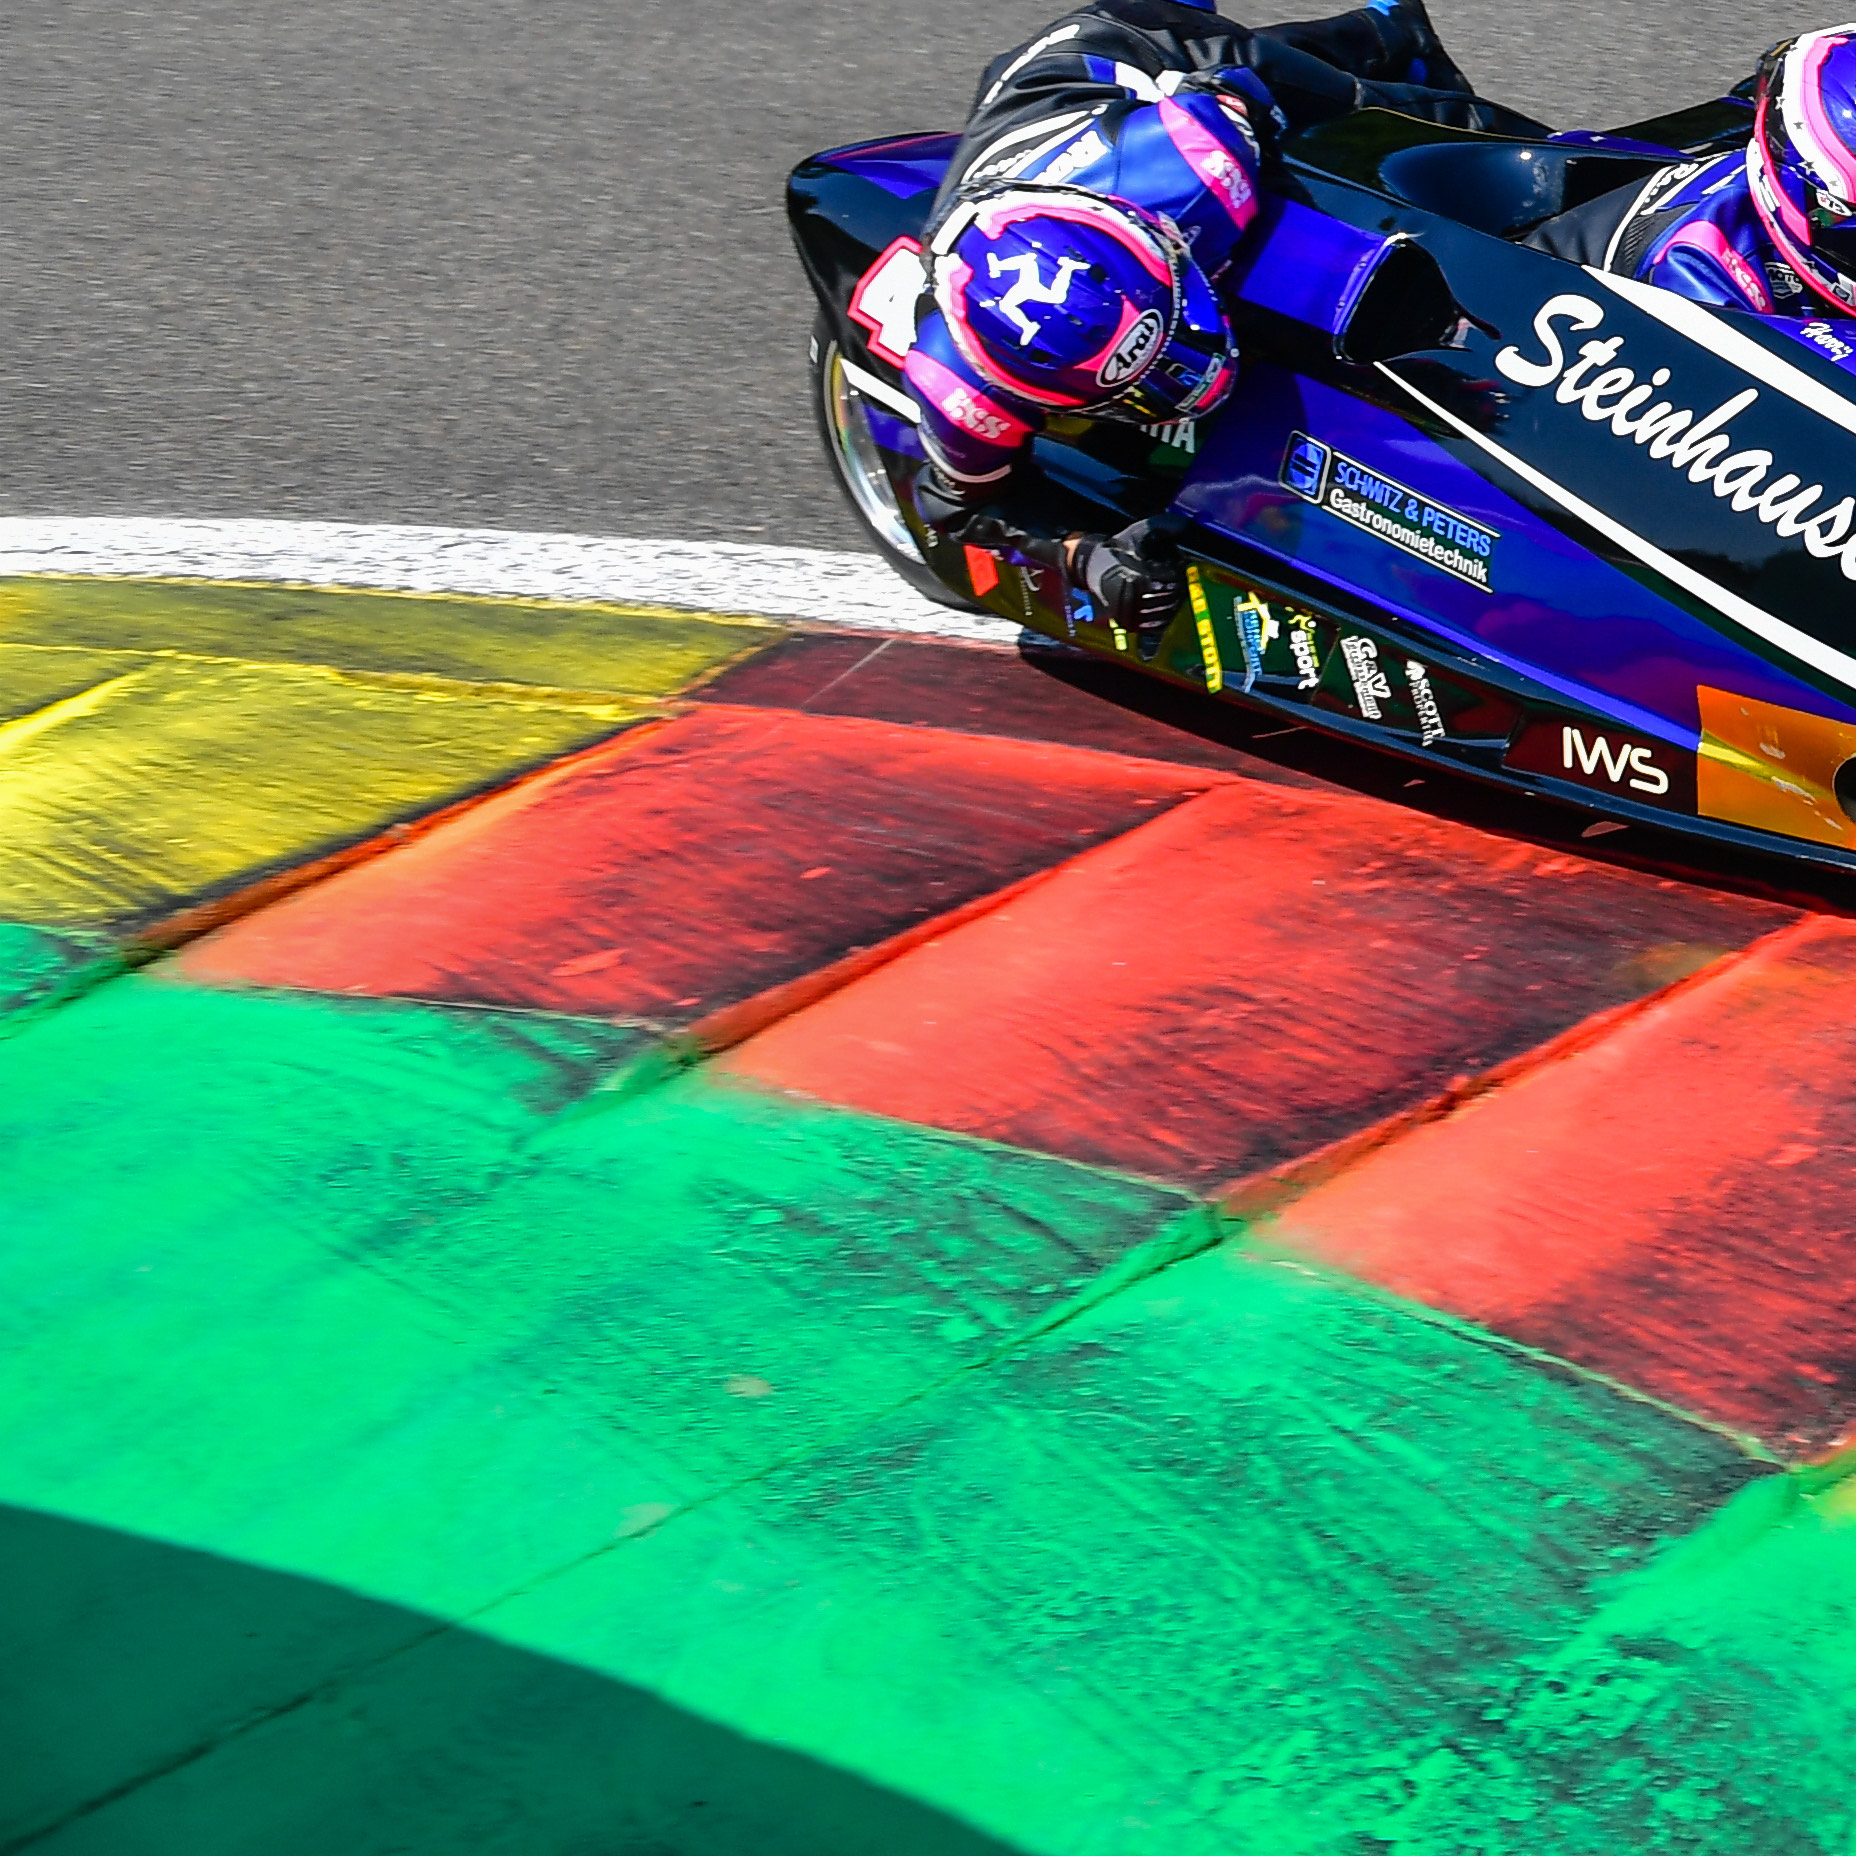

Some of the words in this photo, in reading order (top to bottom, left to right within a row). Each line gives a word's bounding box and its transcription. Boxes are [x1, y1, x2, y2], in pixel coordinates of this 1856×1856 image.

[1114, 319, 1156, 378] Arai
[1329, 488, 1488, 583] Gastronomietechnik
[1334, 461, 1404, 514] SCHMITZ
[1404, 498, 1419, 522] &
[1421, 505, 1492, 557] PETERS
[1416, 678, 1446, 738] SCOTT
[1562, 726, 1669, 795] IWS
